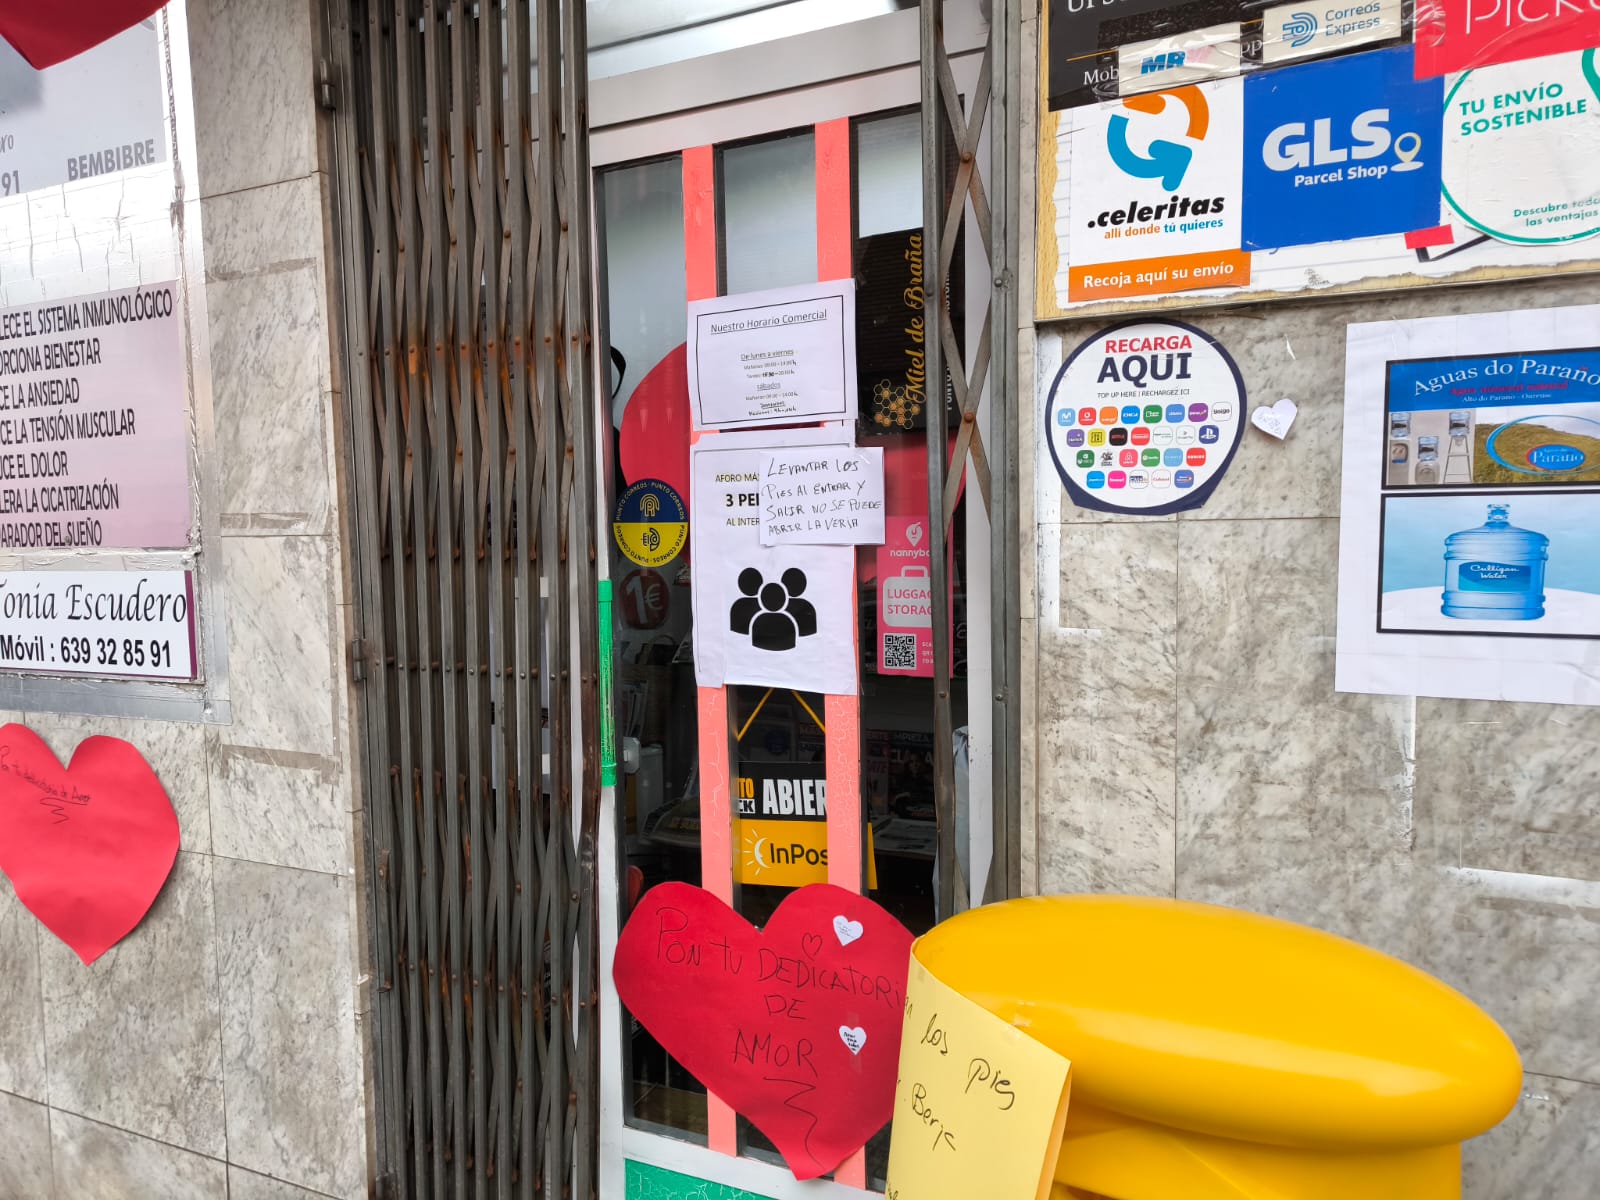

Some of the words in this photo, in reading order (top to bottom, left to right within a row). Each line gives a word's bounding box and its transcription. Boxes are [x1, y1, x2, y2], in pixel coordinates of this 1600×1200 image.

[1325, 3, 1380, 21] Correos
[1325, 16, 1380, 36] Express
[1084, 66, 1119, 85] Mob
[1459, 98, 1485, 116] TU
[1493, 82, 1563, 109] ENVÍO
[1460, 99, 1587, 136] SOSTENIBLE
[1262, 108, 1391, 171] GLS
[67, 139, 155, 181] BEMBIBRE
[1294, 169, 1343, 187] Parcel
[1347, 165, 1388, 179] Shop
[1513, 202, 1568, 217] Descubre
[1526, 218, 1543, 226] las
[1547, 209, 1599, 223] ventajas
[1125, 224, 1161, 237] donde
[1164, 221, 1176, 233] tú
[1180, 218, 1224, 233] quieres
[903, 233, 924, 310] Braña
[1083, 272, 1131, 288] Recoja
[1136, 267, 1167, 285] aquí
[1172, 269, 1188, 280] su
[1193, 263, 1234, 277] envío
[23, 310, 37, 337] EL
[38, 303, 81, 335] SISTEMA
[83, 286, 173, 329] INMUNOLÓGICO
[711, 322, 745, 333] Nuestro
[747, 318, 780, 329] Horario
[782, 310, 828, 324] Comercial
[904, 315, 924, 342] de
[44, 338, 101, 370] BIENESTAR
[1105, 335, 1192, 353] RECARGA
[904, 350, 926, 403] Miel
[1097, 352, 1192, 388] AQUI
[1415, 366, 1478, 395] Aguas
[1485, 360, 1513, 376] do
[1522, 359, 1600, 386] Paraño
[12, 383, 25, 409] LA
[28, 378, 79, 408] ANSIEDAD
[1121, 390, 1137, 398] HERE
[1142, 389, 1179, 397] RECHARGEZ
[1180, 388, 1190, 396] ICI
[14, 418, 28, 444] LA
[29, 409, 75, 443] TENSIÓN
[76, 409, 135, 440] MUSCULAR
[17, 454, 30, 478] EL
[31, 451, 68, 478] DOLOR
[716, 473, 742, 482] AFORO
[744, 472, 759, 482] MÁ
[768, 457, 828, 477] LEVANTAR
[25, 487, 39, 512] LA
[41, 478, 119, 513] CICATRIZACIÓN
[726, 493, 734, 507] 3
[738, 493, 759, 507] PE
[814, 482, 851, 494] ENTRAR
[857, 480, 866, 496] Y
[812, 503, 826, 514] NO
[829, 500, 845, 511] SE
[848, 498, 881, 511] PUEDE
[45, 521, 65, 547] DEL
[67, 517, 102, 547] SUEÑO
[726, 518, 736, 526] AL
[738, 517, 760, 526] INTER
[769, 523, 802, 536] ABRIR
[808, 519, 821, 530] LA
[1470, 564, 1520, 574] Culligan
[66, 578, 187, 623] Escudero
[0, 634, 45, 661] Móvil
[61, 637, 91, 664] 639
[97, 638, 118, 665] 32
[123, 639, 145, 666] 85
[151, 640, 171, 668] 91
[763, 779, 827, 816] ABIER
[770, 842, 828, 866] InPos
[764, 994, 806, 1020] DE
[920, 1013, 948, 1057] los
[734, 1029, 818, 1077] AMOR
